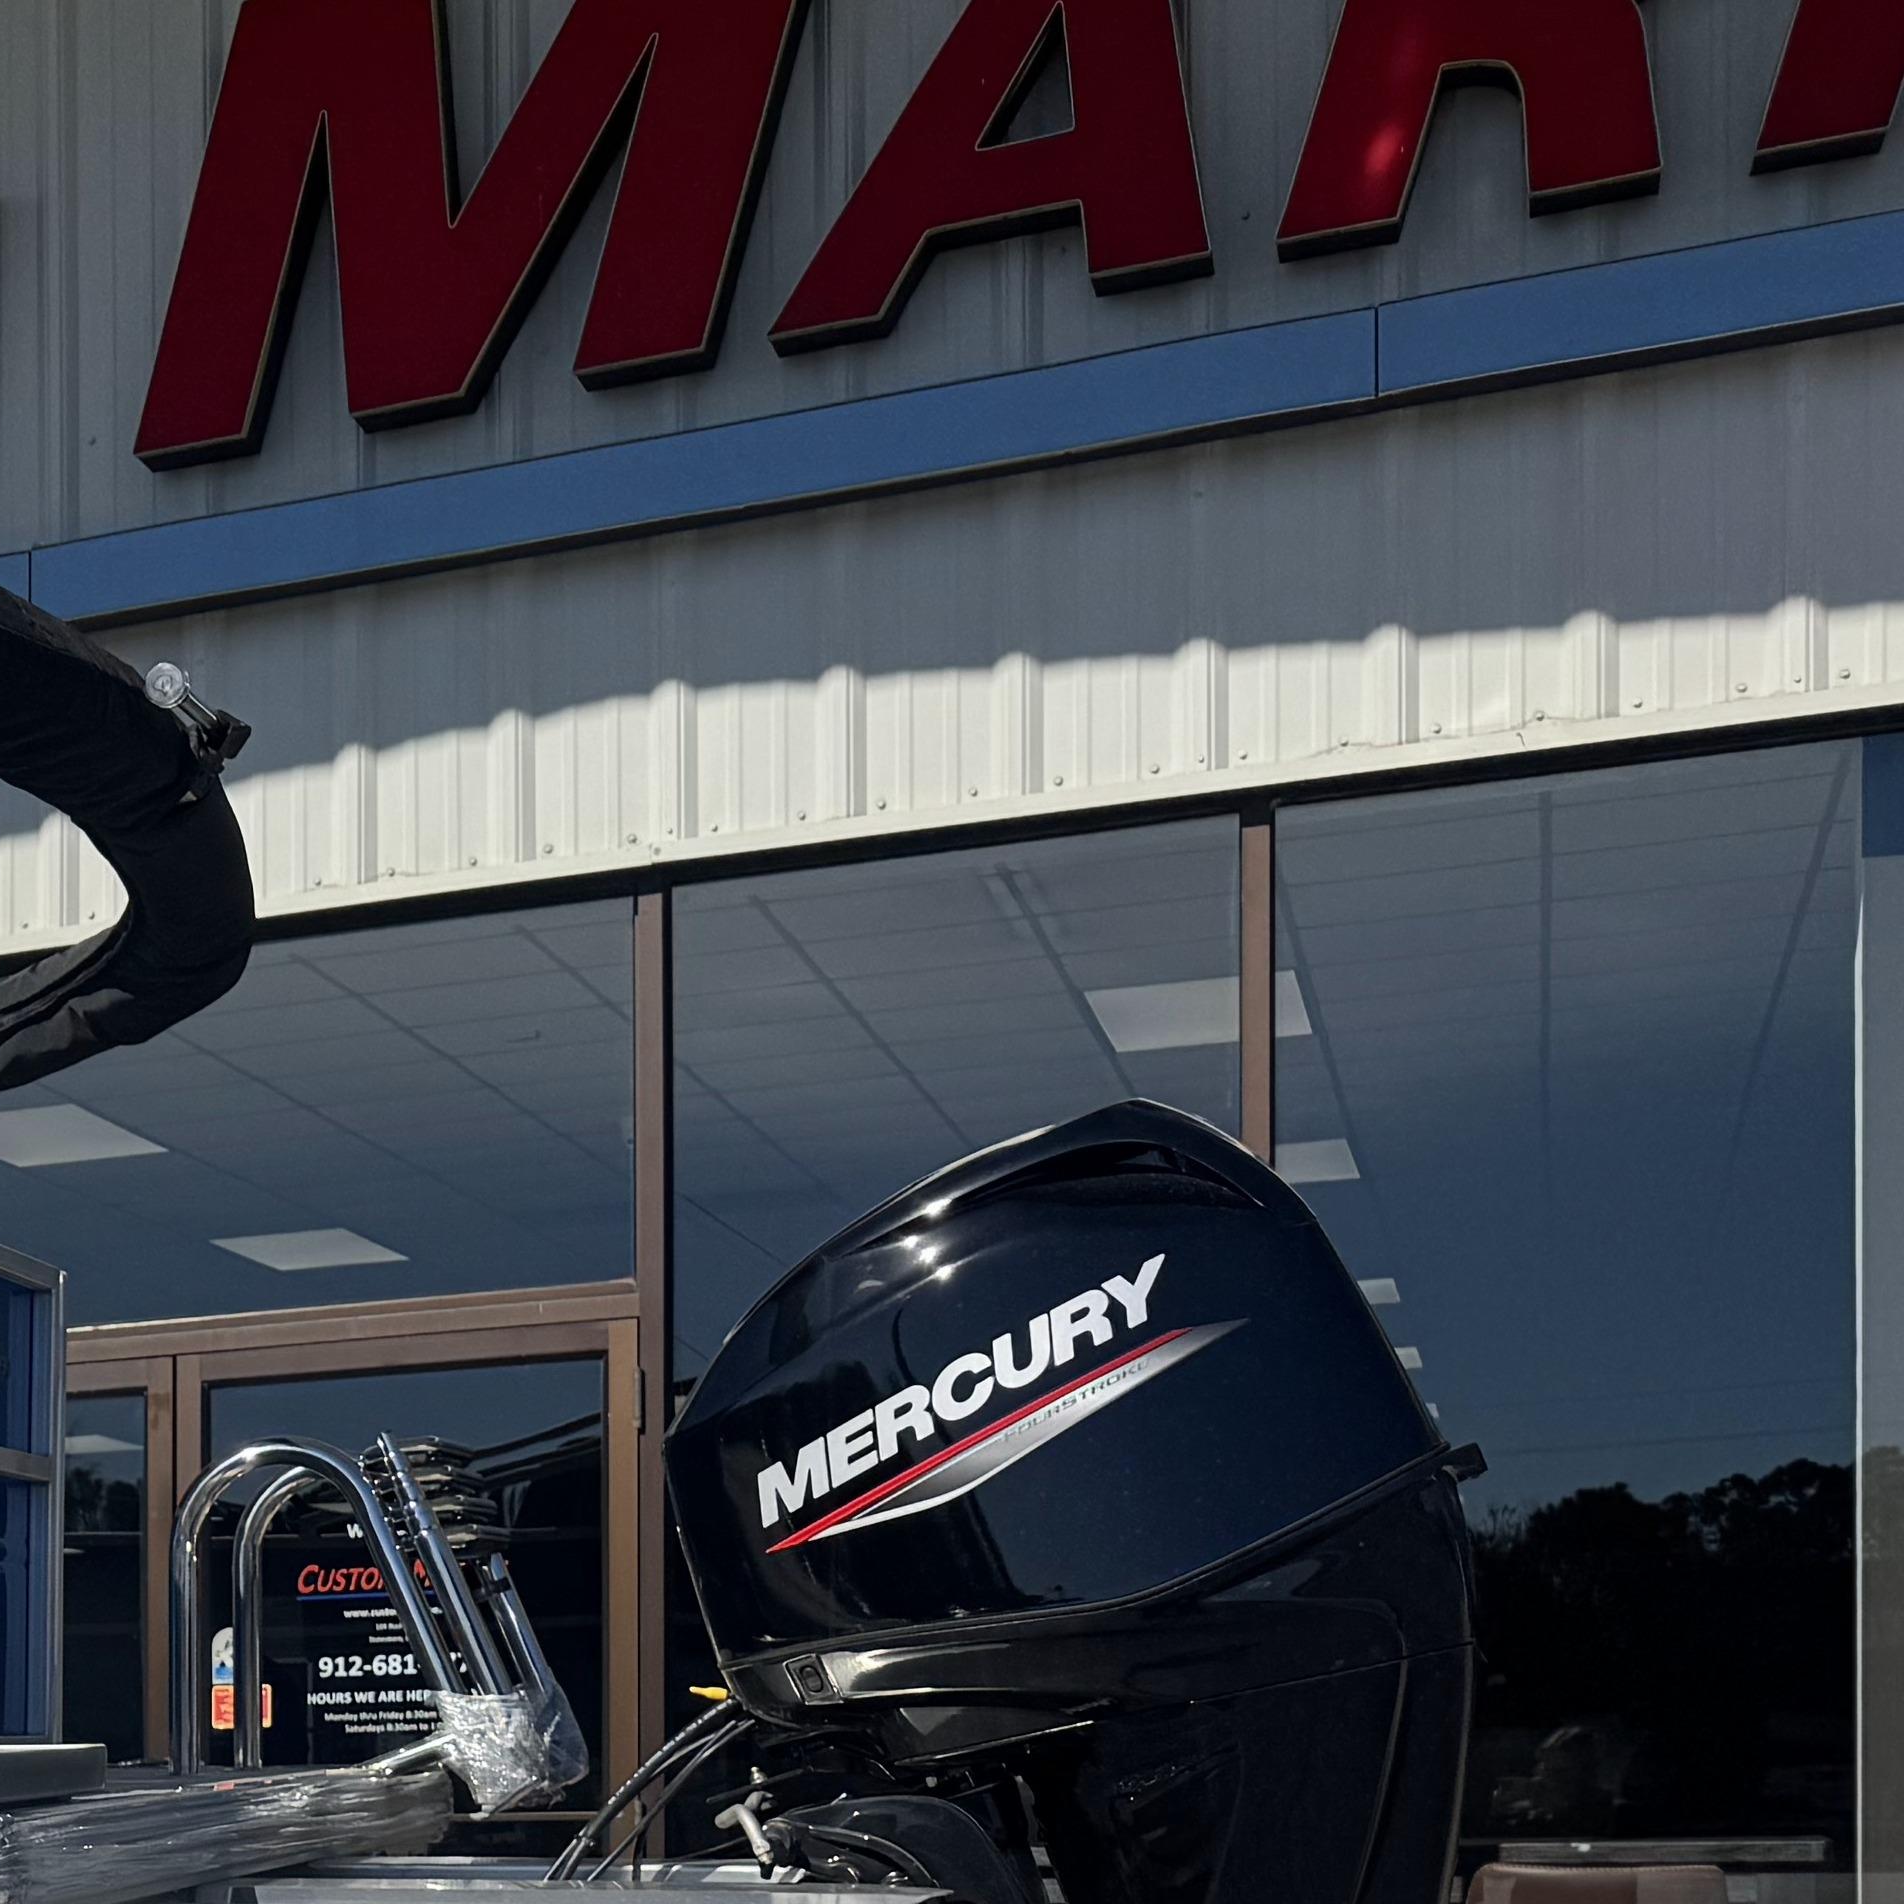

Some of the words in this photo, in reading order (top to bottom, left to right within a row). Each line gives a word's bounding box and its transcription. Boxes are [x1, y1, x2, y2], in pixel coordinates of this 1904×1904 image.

[755, 1252, 1168, 1528] MERCURY
[1003, 1356, 1153, 1442] FOURSTROKE
[318, 1653, 421, 1678] 912-681
[307, 1691, 353, 1705] HOURS
[354, 1690, 376, 1704] WE
[378, 1689, 404, 1702] ARE
